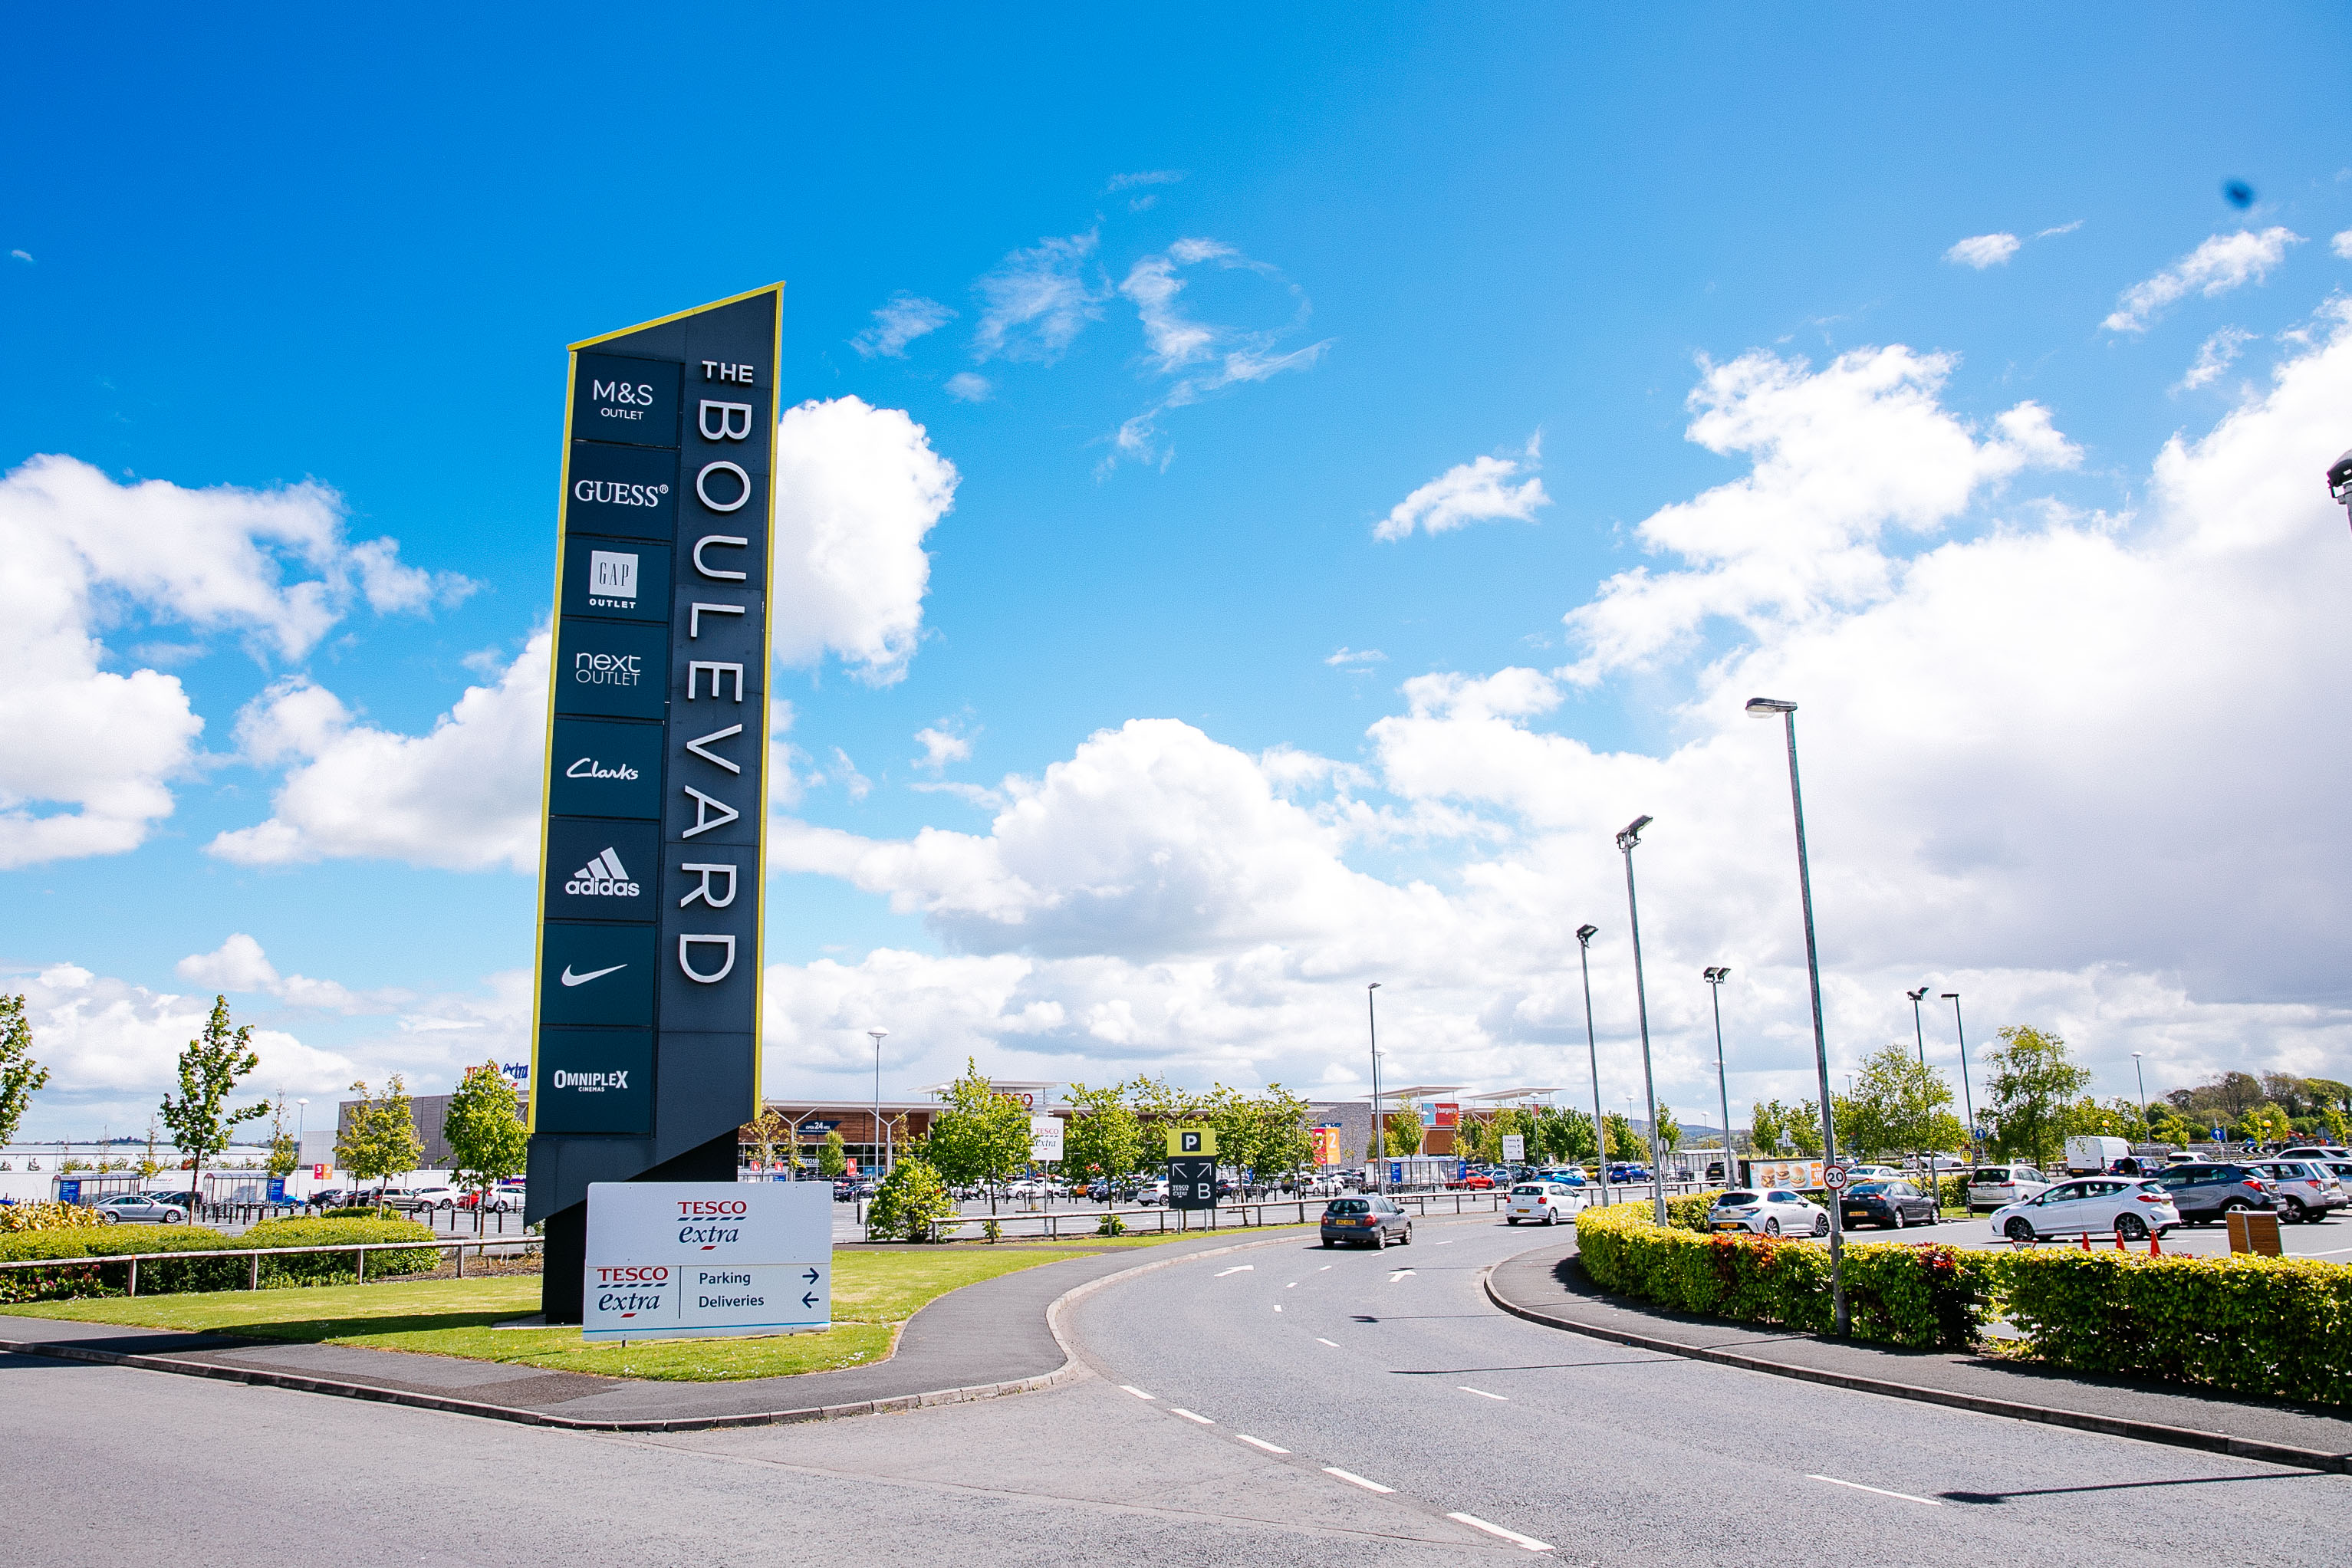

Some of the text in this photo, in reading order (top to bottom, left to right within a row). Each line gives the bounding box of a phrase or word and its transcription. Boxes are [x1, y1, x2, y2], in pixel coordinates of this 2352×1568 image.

[702, 360, 754, 383] THE
[593, 380, 653, 406] M&S
[600, 407, 644, 420] OUTLET
[599, 563, 629, 587] GAP
[589, 597, 637, 610] OUTLET
[576, 653, 641, 672] next
[576, 669, 641, 686] OUTLET
[679, 399, 752, 983] BOULEVARD
[566, 758, 639, 780] Clarks
[565, 877, 640, 897] adidas
[1035, 1139, 1057, 1147] extra
[1186, 1135, 1198, 1150] P
[1329, 1132, 1337, 1149] 2
[316, 1165, 323, 1174] 3
[1827, 1172, 1844, 1182] 20
[1197, 1182, 1212, 1200] B
[677, 1201, 747, 1215] TESCO
[679, 1225, 739, 1243] extra
[597, 1267, 669, 1281] TESCO
[699, 1272, 752, 1286] Parking
[598, 1293, 660, 1310] extra
[699, 1294, 765, 1308] Deliveries
